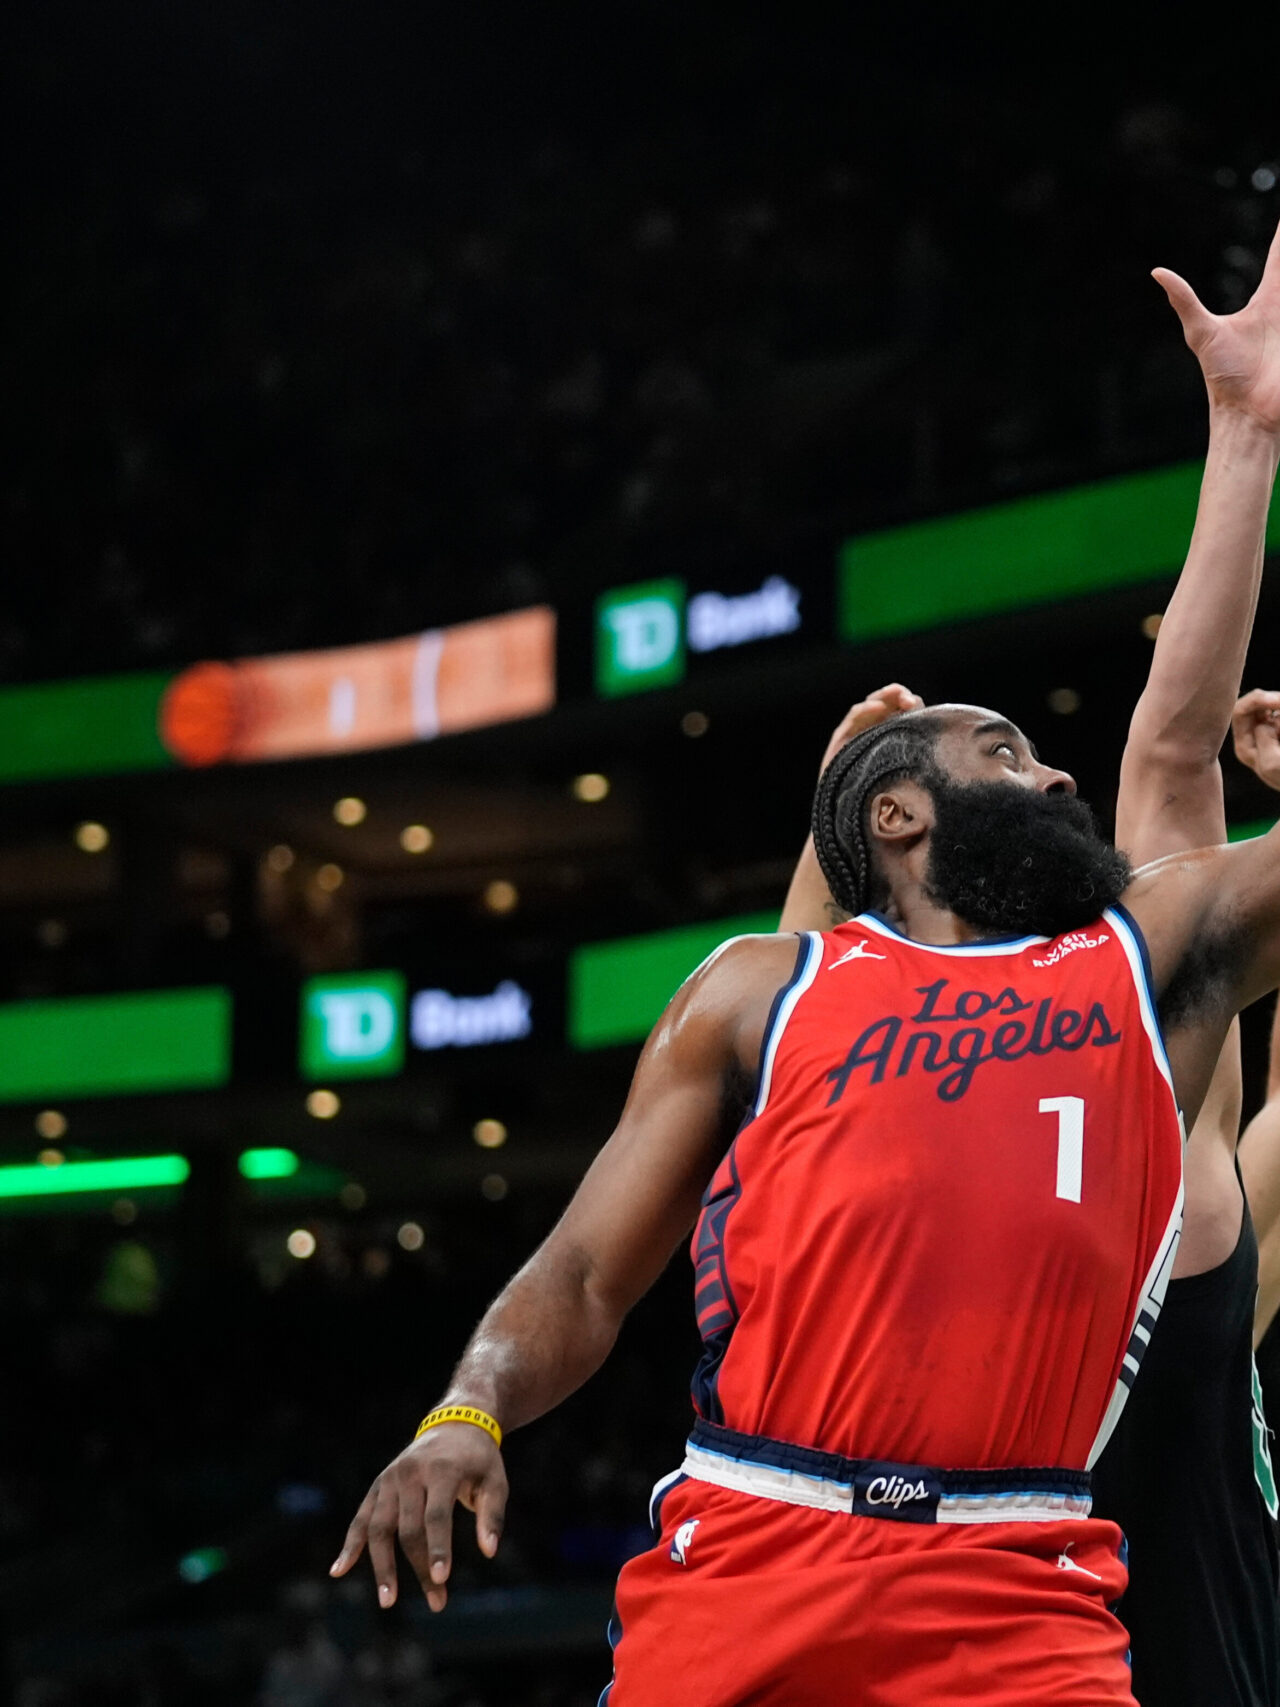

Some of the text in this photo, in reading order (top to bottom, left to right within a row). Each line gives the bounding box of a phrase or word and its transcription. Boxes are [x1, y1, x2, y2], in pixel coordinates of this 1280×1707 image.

[604, 575, 801, 672] TD Bank
[1032, 934, 1110, 968] RWANDA
[1046, 933, 1087, 958] VISIT
[309, 980, 532, 1061] TD Bank
[911, 978, 1034, 1024] Los
[824, 997, 1122, 1109] Angeles
[1038, 1095, 1085, 1205] 1
[866, 1476, 930, 1509] Clips
